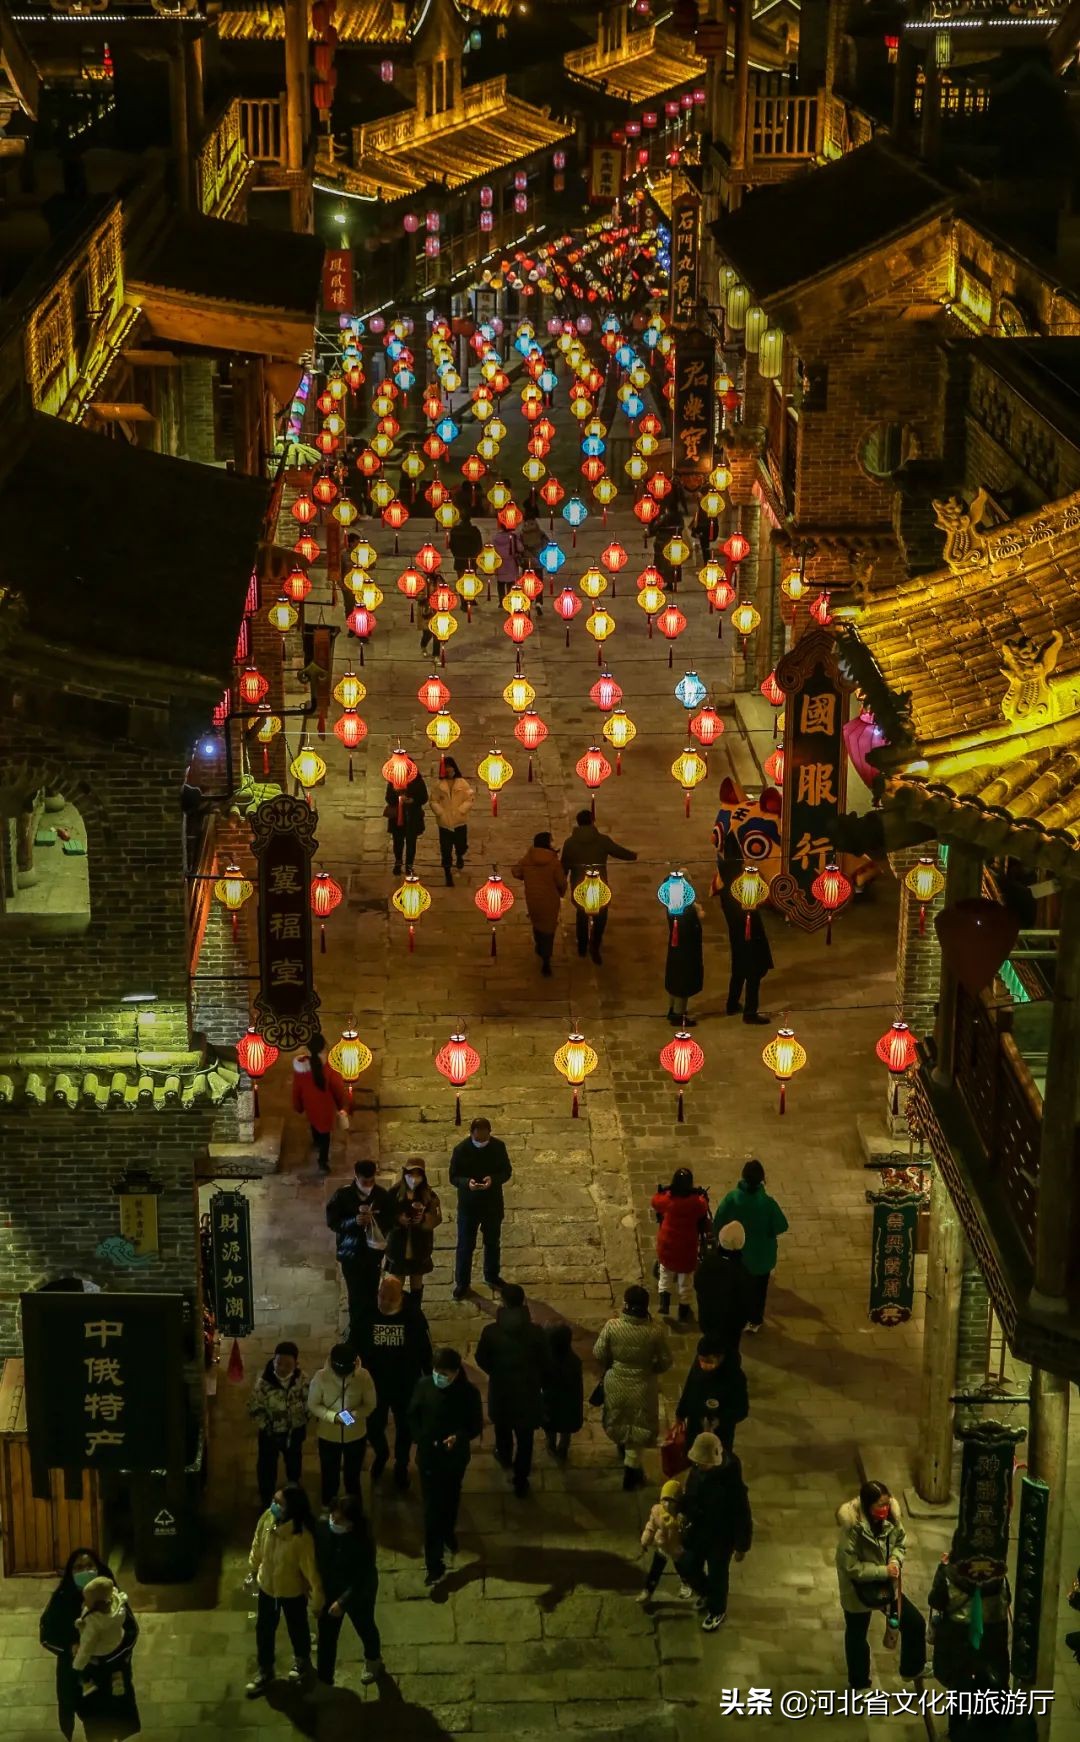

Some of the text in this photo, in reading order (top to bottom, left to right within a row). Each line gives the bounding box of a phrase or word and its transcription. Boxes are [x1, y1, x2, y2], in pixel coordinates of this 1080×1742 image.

[791, 692, 837, 872] 國服行
[268, 864, 304, 986] 冀福堂
[218, 1213, 244, 1319] 財源如潮
[84, 1319, 126, 1457] 中俄特产
